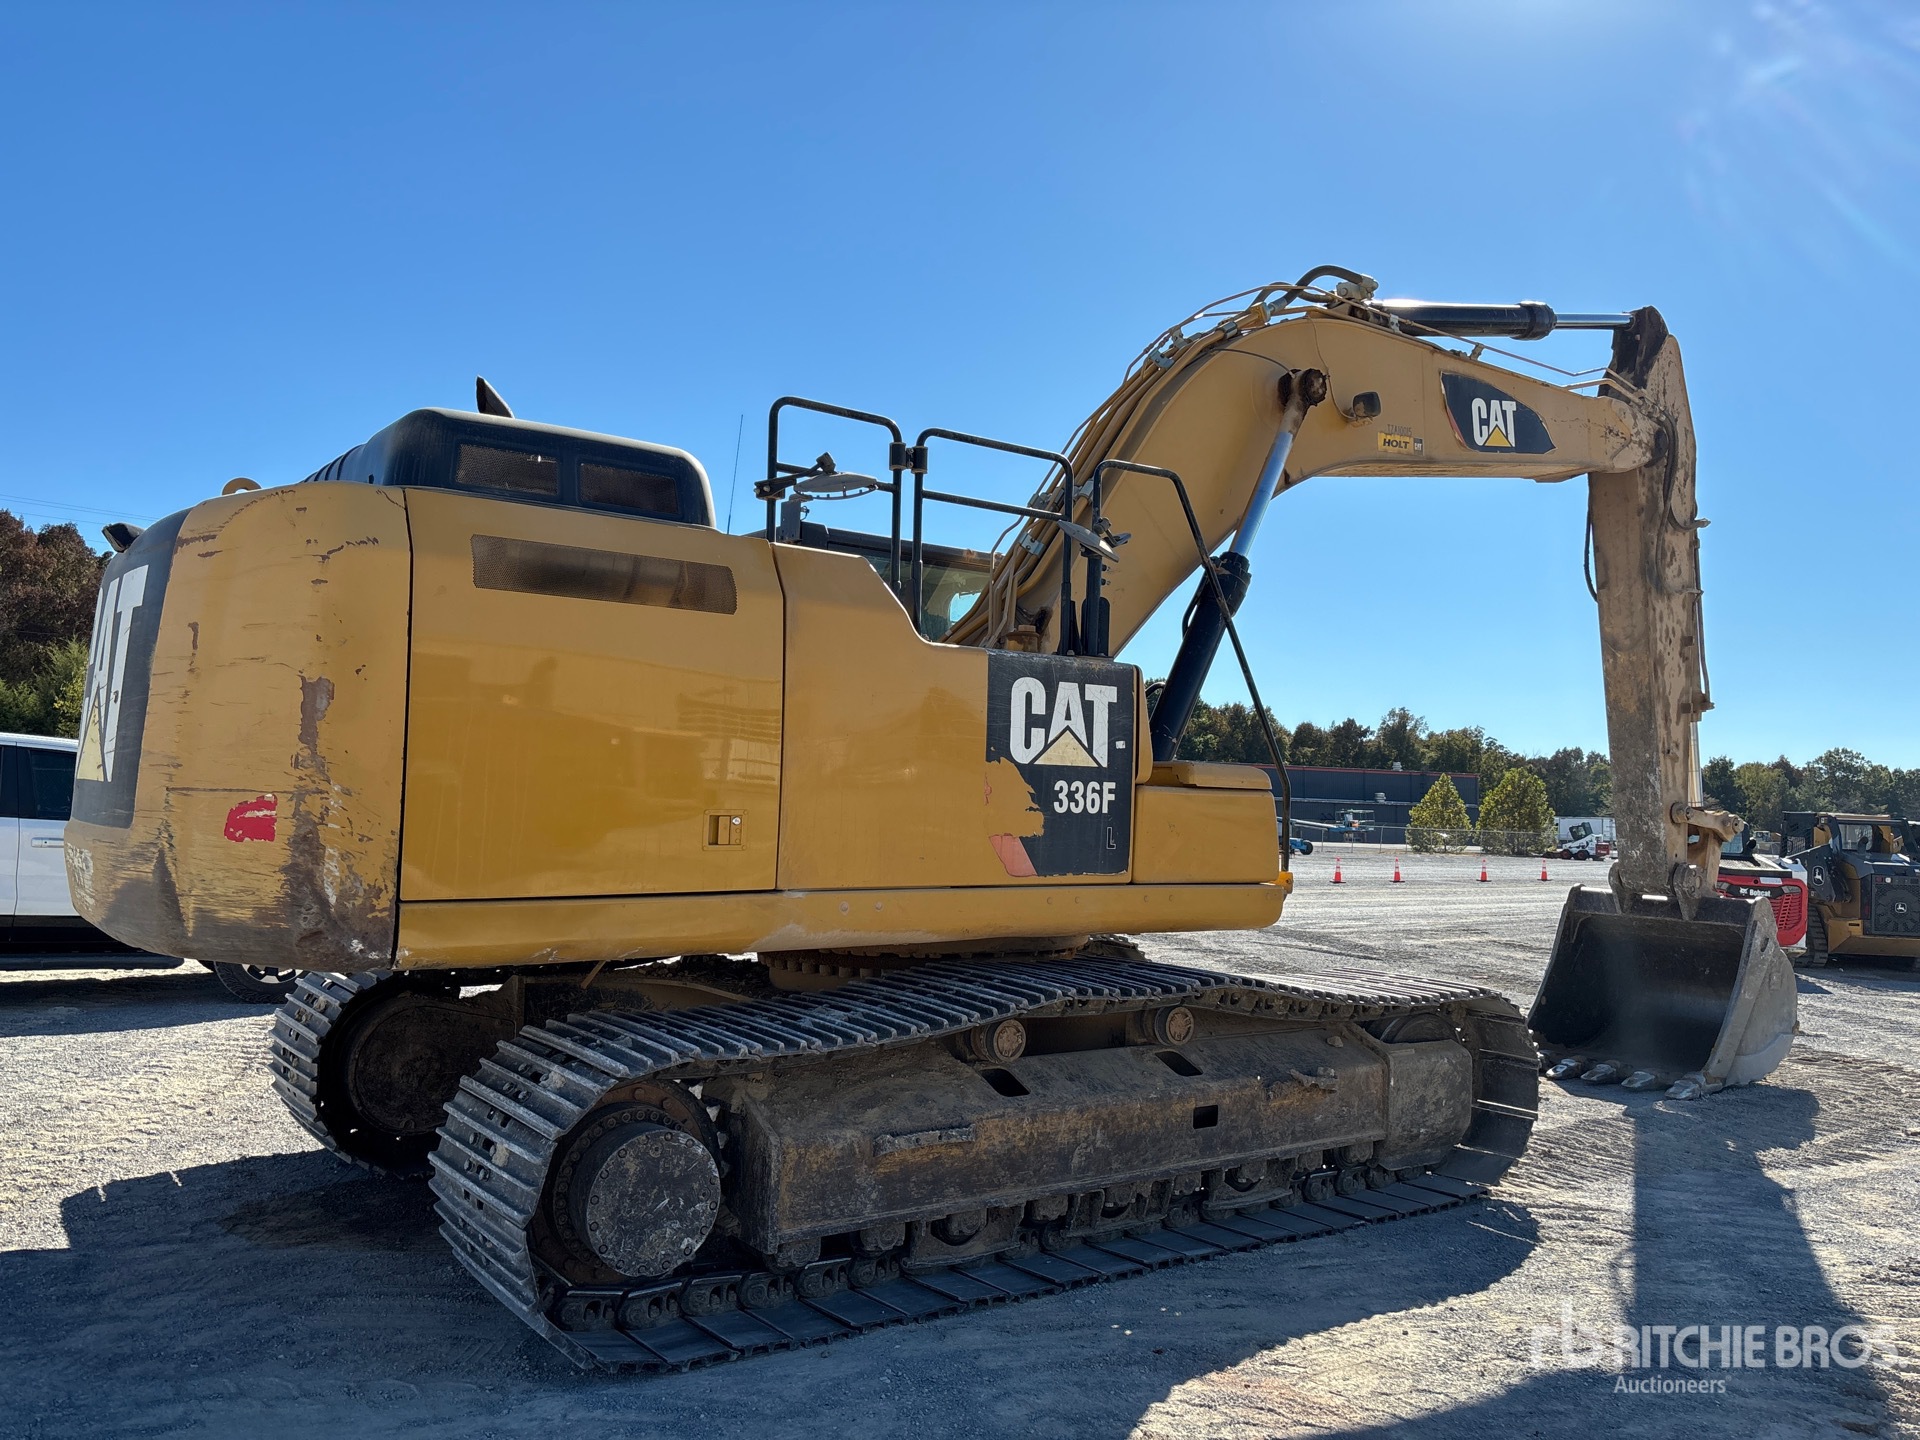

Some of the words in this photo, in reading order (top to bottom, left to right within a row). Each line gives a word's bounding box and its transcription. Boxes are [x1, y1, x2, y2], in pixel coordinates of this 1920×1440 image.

[1471, 397, 1516, 448] CAT
[1382, 438, 1410, 449] HOLT
[1010, 677, 1118, 768] CAT
[1053, 780, 1117, 814] 336F
[1106, 826, 1116, 850] L
[1750, 889, 1770, 897] Bobcat
